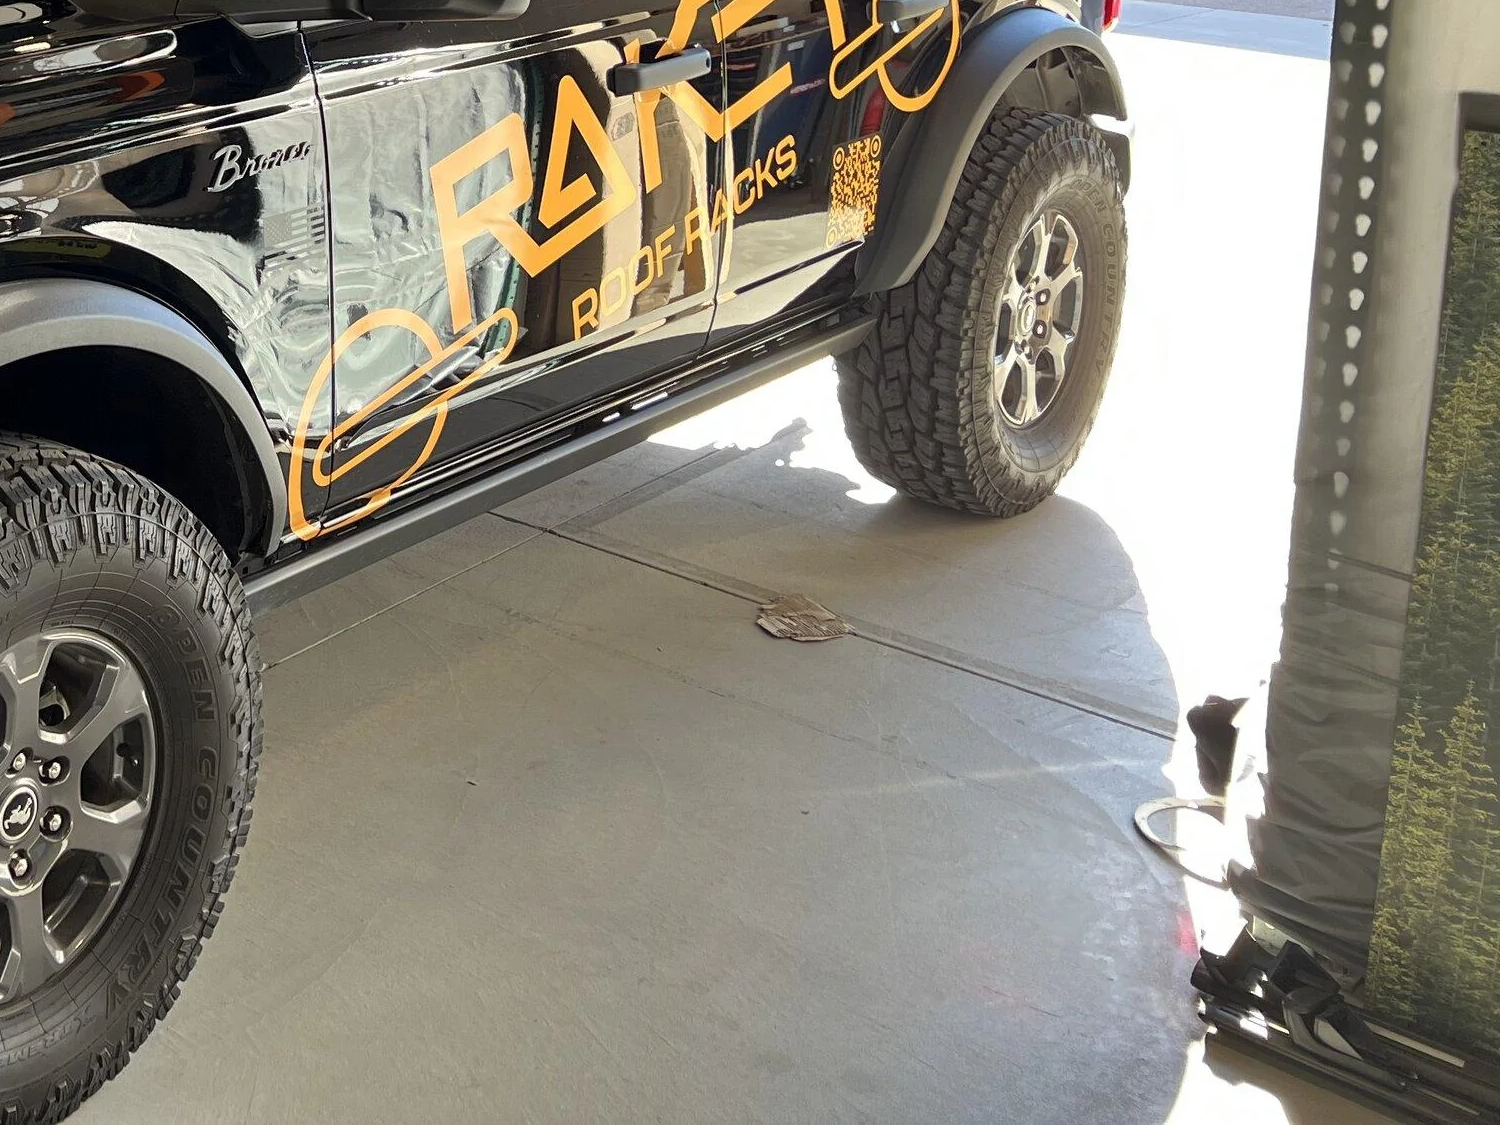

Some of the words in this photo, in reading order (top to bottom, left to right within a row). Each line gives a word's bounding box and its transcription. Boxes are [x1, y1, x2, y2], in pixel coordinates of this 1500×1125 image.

[206, 141, 312, 193] Bronco
[571, 224, 678, 343] ROOF
[684, 134, 799, 257] RACKS
[1092, 212, 1128, 381] COUNTRY
[150, 600, 218, 723] OPEN
[106, 741, 220, 997] COUNTRY
